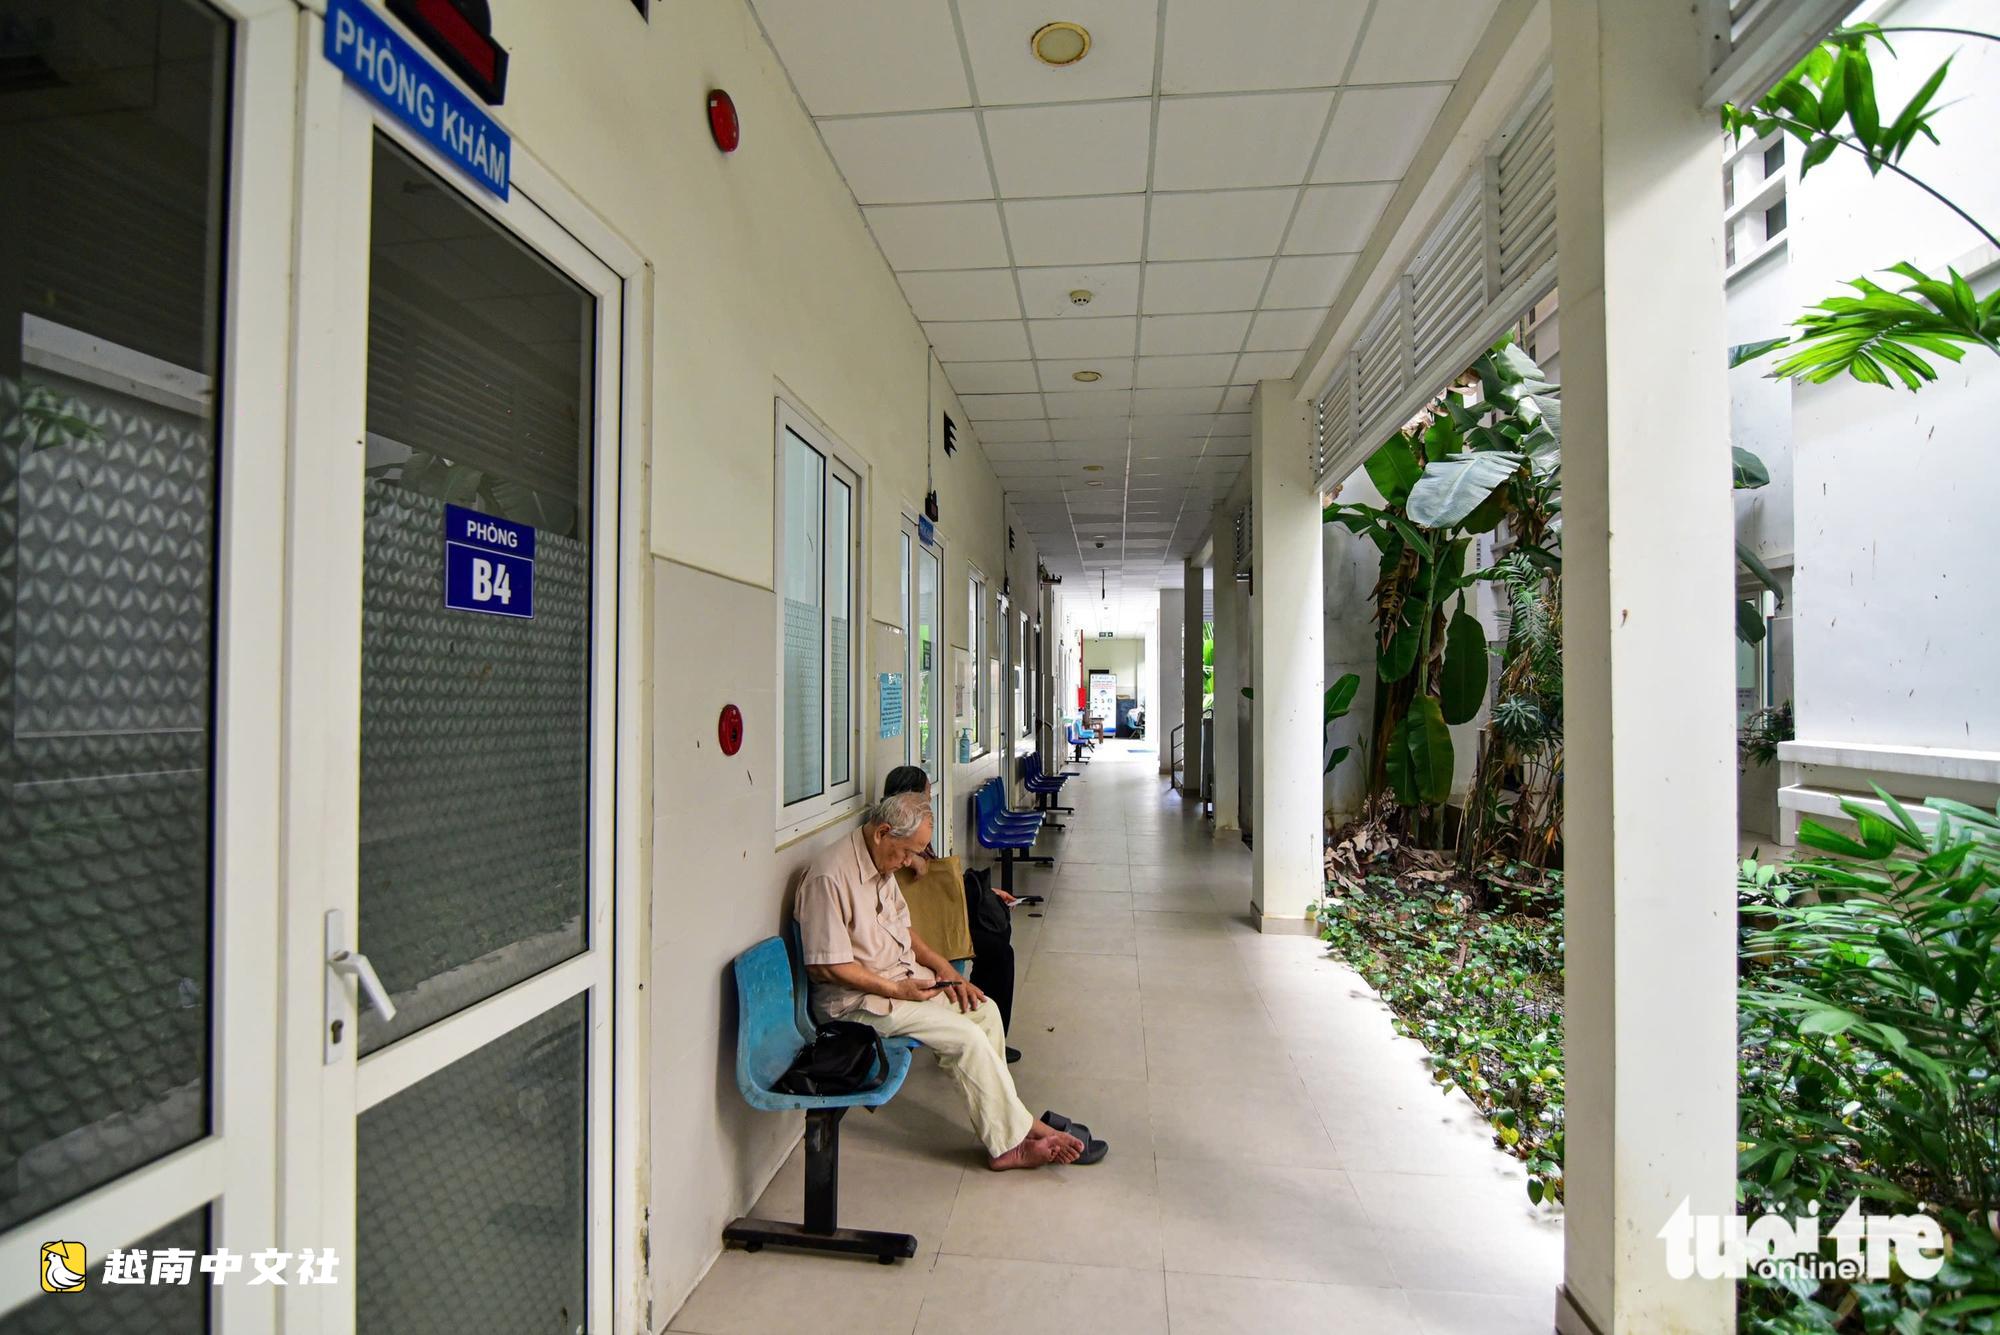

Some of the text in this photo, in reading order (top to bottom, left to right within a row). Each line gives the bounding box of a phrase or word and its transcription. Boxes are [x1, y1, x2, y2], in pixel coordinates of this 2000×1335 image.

[335, 8, 506, 189] PHÒNG KHÁM
[466, 519, 519, 548] PHÒNG
[472, 557, 512, 605] B4
